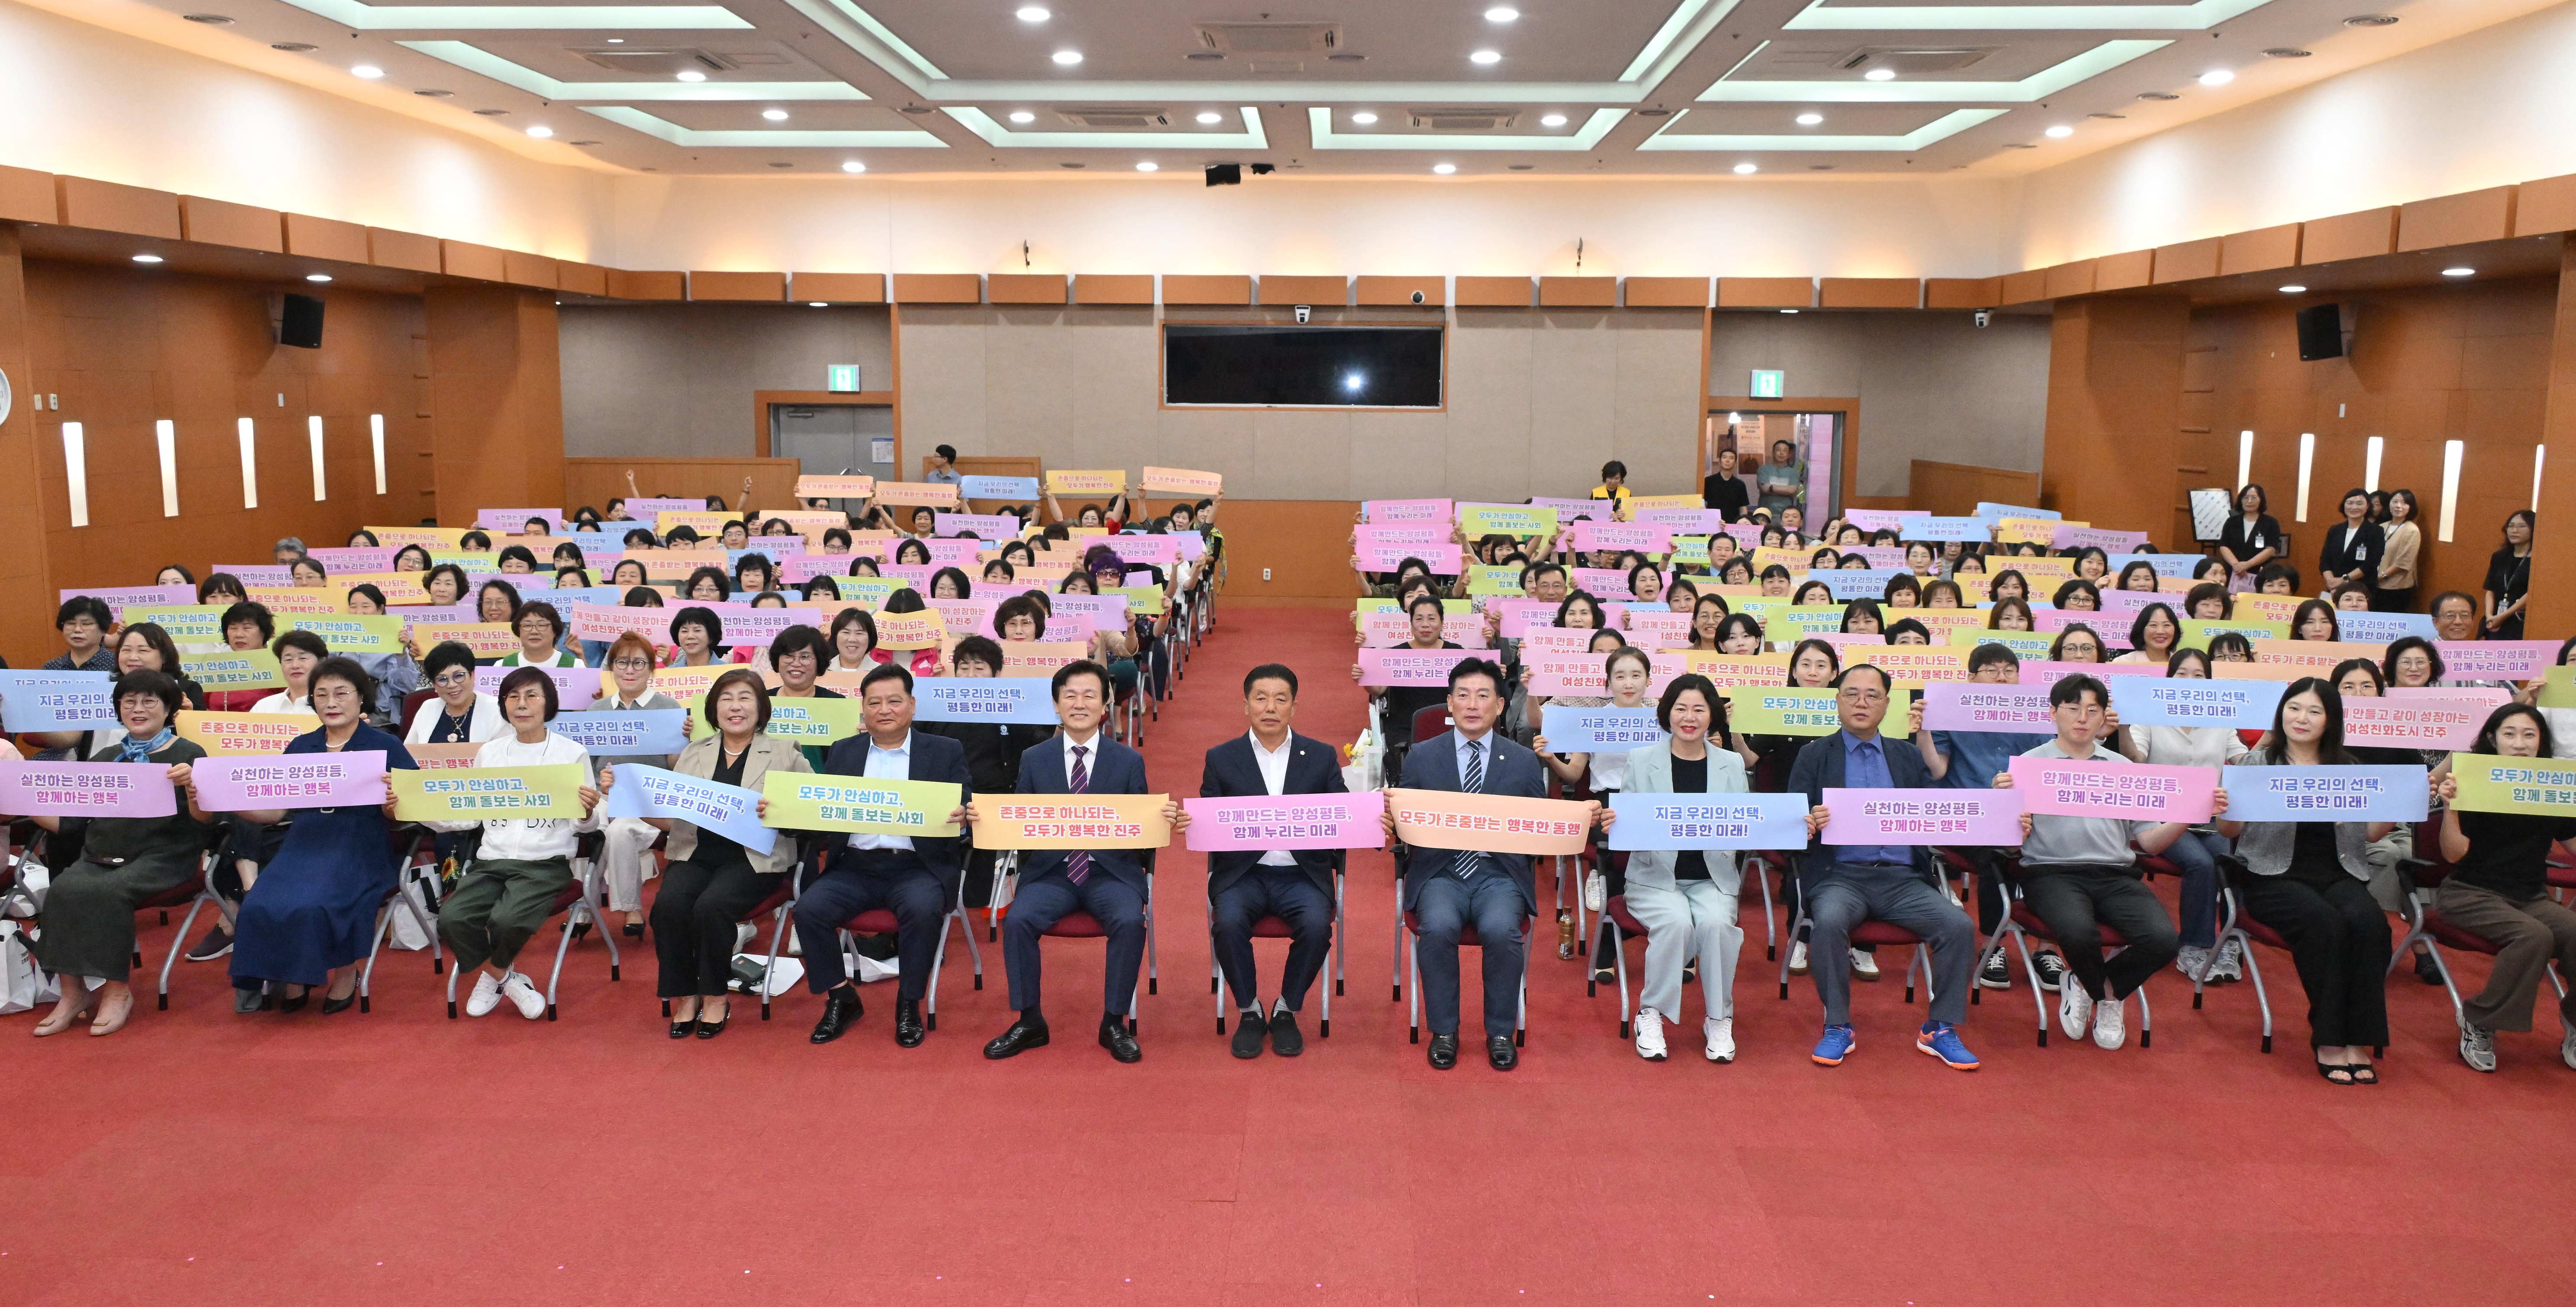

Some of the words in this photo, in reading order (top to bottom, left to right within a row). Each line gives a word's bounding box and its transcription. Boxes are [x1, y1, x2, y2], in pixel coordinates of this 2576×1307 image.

[585, 613, 610, 623] 만들고
[612, 615, 630, 624] 같이
[632, 616, 669, 626] 성장하는
[2357, 620, 2385, 629] 우리의
[294, 621, 323, 632] 모두가
[331, 634, 358, 644] 돌보는
[361, 635, 379, 644] 사회
[2346, 630, 2374, 640] 평등한
[2376, 632, 2399, 642] 미래!
[1868, 655, 1911, 666] 존중으로
[1914, 655, 1961, 666] 하나되는,
[2443, 650, 2493, 659] 함께만드는
[1696, 663, 1740, 674] 존중으로
[2453, 662, 2472, 671] 함께
[2476, 662, 2506, 671] 누리는
[2509, 662, 2529, 671] 미래
[192, 673, 215, 684] 함께
[217, 673, 249, 683] 돌보는
[251, 671, 272, 681] 사회
[1921, 670, 1954, 680] 행복한
[39, 695, 64, 706] 지금
[68, 694, 104, 705] 우리의
[933, 688, 956, 699] 지금
[960, 688, 994, 699] 우리의
[998, 689, 1025, 700] 선택,
[1960, 694, 2010, 707] 실천하는
[2152, 689, 2176, 700] 지금
[2180, 690, 2217, 702] 우리의
[2221, 691, 2249, 704] 선택,
[947, 702, 982, 712] 평등한
[985, 702, 1012, 713] 미래!
[1763, 697, 1801, 709] 모두가
[55, 708, 92, 720] 평등한
[1974, 709, 2023, 721] 함께하는
[2167, 704, 2204, 716] 평등한
[2207, 706, 2236, 717] 미래!
[2353, 708, 2388, 720] 만들고
[2393, 710, 2417, 722] 같이
[2420, 711, 2469, 724] 성장하는
[1581, 718, 1605, 728] 지금
[1608, 718, 1643, 728] 우리의
[1783, 713, 1808, 725] 함께
[201, 722, 249, 733] 존중으로
[557, 722, 580, 733] 지금
[583, 721, 618, 732] 우리의
[621, 721, 649, 733] 선택,
[765, 720, 802, 734] 돌보는
[805, 723, 828, 735] 사회
[2346, 723, 2419, 737] 여성친화도시
[2423, 726, 2447, 738] 진주
[610, 735, 637, 745] 미래!
[1594, 731, 1630, 742] 평등한
[1633, 731, 1660, 742] 미래!
[221, 738, 257, 749] 모두가
[231, 767, 284, 781] 실천하는
[289, 765, 346, 779] 양성평등,
[2490, 769, 2533, 783] 모두가
[21, 774, 73, 787] 실천하는
[78, 775, 133, 789] 양성평등,
[424, 780, 465, 792] 모두가
[469, 778, 528, 791] 안심하고,
[2043, 771, 2115, 788] 함께만드는
[2120, 776, 2181, 793] 양성평등,
[2270, 778, 2298, 791] 지금
[2303, 778, 2346, 791] 우리의
[2350, 778, 2383, 792] 선택,
[246, 783, 300, 797] 함께하는
[304, 782, 330, 795] 행복
[2513, 788, 2540, 802] 함께
[36, 791, 89, 804] 함께하는
[93, 791, 118, 804] 행복
[449, 796, 476, 808] 함께
[480, 795, 520, 808] 돌보는
[524, 794, 550, 806] 사회
[642, 777, 669, 790] 지금
[670, 783, 713, 801] 우리의
[715, 793, 744, 817] 선택,
[799, 786, 841, 801] 모두가
[845, 789, 903, 807] 안심하고,
[2058, 789, 2085, 803] 함께
[2090, 791, 2132, 806] 누리는
[2137, 795, 2165, 808] 미래
[2286, 795, 2330, 808] 평등한
[2333, 795, 2367, 808] 미래!
[654, 793, 694, 810] 평등한
[696, 802, 728, 822] 미래!
[1000, 806, 1055, 819] 존중으로
[1058, 806, 1120, 822] 하나되는,
[1655, 807, 1683, 820] 지금
[1686, 807, 1728, 820] 우리의
[1732, 807, 1764, 821] 선택,
[1864, 802, 1920, 815] 실천하는
[1925, 802, 1984, 817] 양성평등,
[821, 805, 848, 820] 함께
[851, 808, 892, 823] 돌보는
[896, 811, 923, 825] 사회
[1217, 809, 1287, 824] 함께만드는
[1291, 807, 1351, 821] 양성평등,
[1400, 811, 1441, 826] 모두가
[1445, 814, 1500, 830] 존중받는
[1507, 818, 1550, 834] 행복한
[1553, 822, 1580, 835] 동행
[1880, 819, 1936, 832] 함께하는
[1940, 819, 1967, 832] 행복
[1023, 824, 1065, 839] 모두가
[1068, 824, 1110, 837] 행복한
[1114, 824, 1141, 837] 진주
[1233, 826, 1260, 839] 함께
[1265, 825, 1305, 838] 누리는
[1310, 824, 1337, 837] 미래
[1671, 824, 1712, 837] 평등한
[1716, 824, 1748, 837] 미래!
